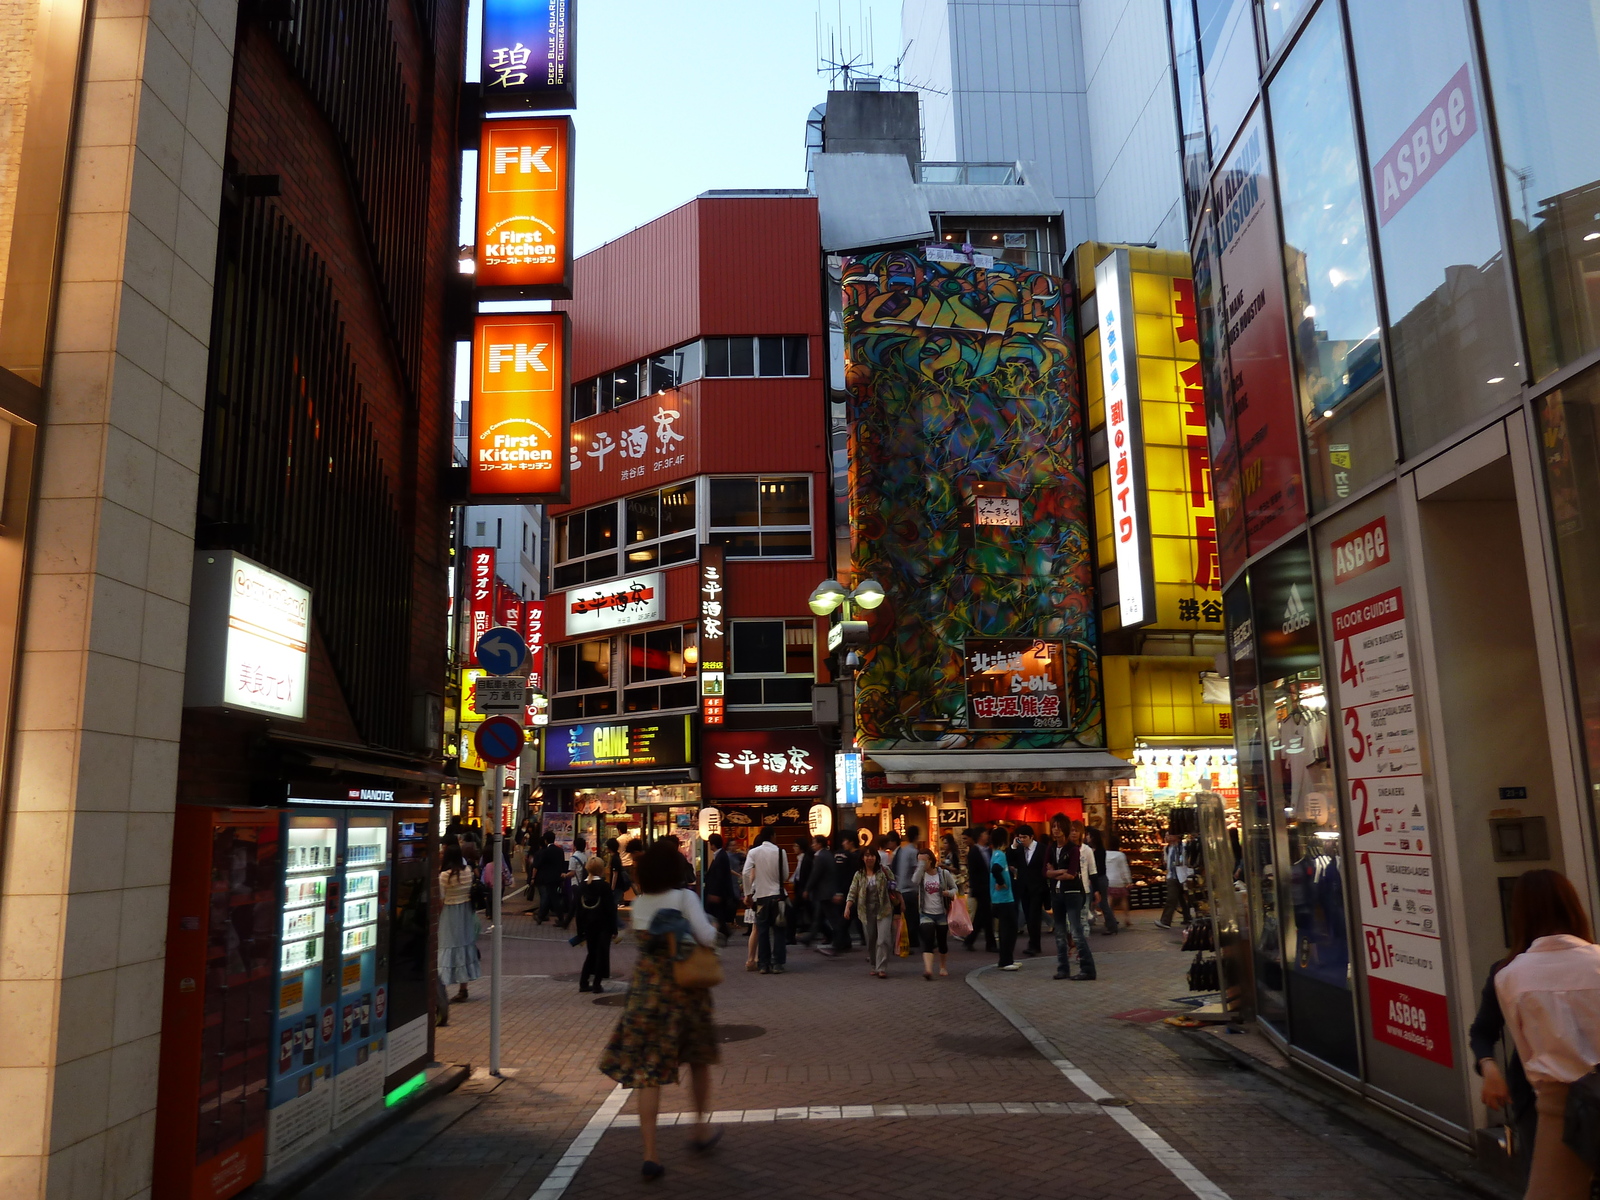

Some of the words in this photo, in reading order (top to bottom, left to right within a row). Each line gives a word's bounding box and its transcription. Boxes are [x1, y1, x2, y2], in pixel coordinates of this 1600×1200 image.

[488, 42, 532, 88] 碧
[494, 145, 553, 174] FK
[1383, 87, 1467, 212] ASBee
[500, 230, 542, 244] First
[485, 243, 556, 256] Kitchen
[485, 257, 522, 265] ファースト
[523, 256, 555, 264] キッチン
[488, 343, 549, 373] FK
[494, 434, 538, 448] First
[480, 448, 552, 462] Kitchen
[480, 463, 517, 471] ファースト
[518, 462, 552, 470] キッチン
[621, 465, 645, 481] 渋谷店
[1336, 526, 1385, 577] ASBee
[475, 553, 490, 600] カラオケ
[1178, 598, 1223, 623] 渋谷
[1336, 608, 1362, 630] FLOOR
[1363, 599, 1391, 622] GUIDE
[528, 609, 542, 655] カラオケ
[1282, 613, 1310, 635] adidas
[1033, 639, 1057, 659] 2F
[1379, 630, 1403, 645] BUSINESS
[971, 651, 1025, 672] 北海道
[1340, 636, 1365, 688] 4F
[478, 680, 523, 689] 自転車を除く
[1011, 673, 1057, 693] らーめん
[477, 691, 523, 700] 一方通行
[973, 694, 1061, 718] 味源熊祭
[593, 725, 629, 758] GAME
[1344, 707, 1373, 763] 3F
[360, 789, 394, 801] NANOTEK
[1378, 787, 1405, 797] SNEAKERS
[947, 810, 965, 823] 2F
[1351, 779, 1381, 836] 2F
[1360, 851, 1388, 908] 1F
[1365, 926, 1395, 970] B1F
[1388, 1000, 1427, 1032] ASBee
